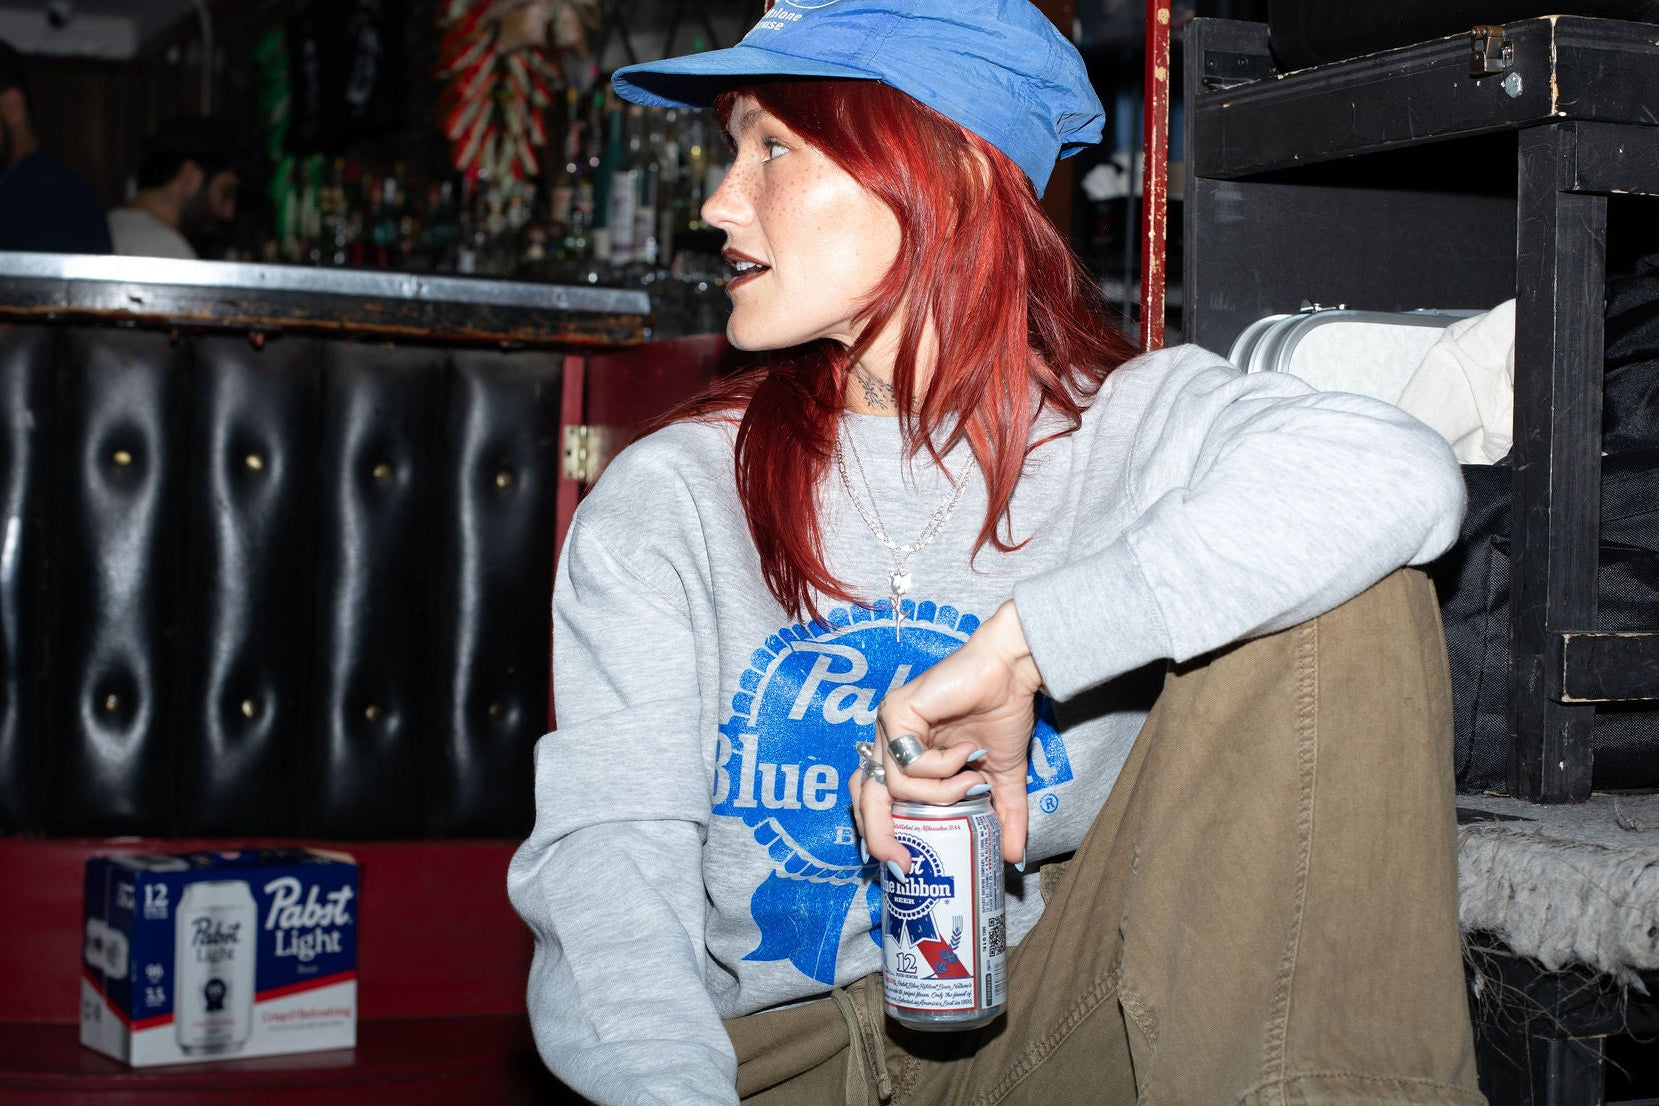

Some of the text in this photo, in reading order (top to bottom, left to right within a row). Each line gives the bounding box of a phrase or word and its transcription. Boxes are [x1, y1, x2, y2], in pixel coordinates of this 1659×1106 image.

[712, 731, 839, 811] Blue
[143, 882, 169, 906] 12
[264, 876, 354, 931] Pabst
[894, 896, 915, 905] BEER
[275, 928, 343, 962] Light
[896, 952, 918, 974] 12
